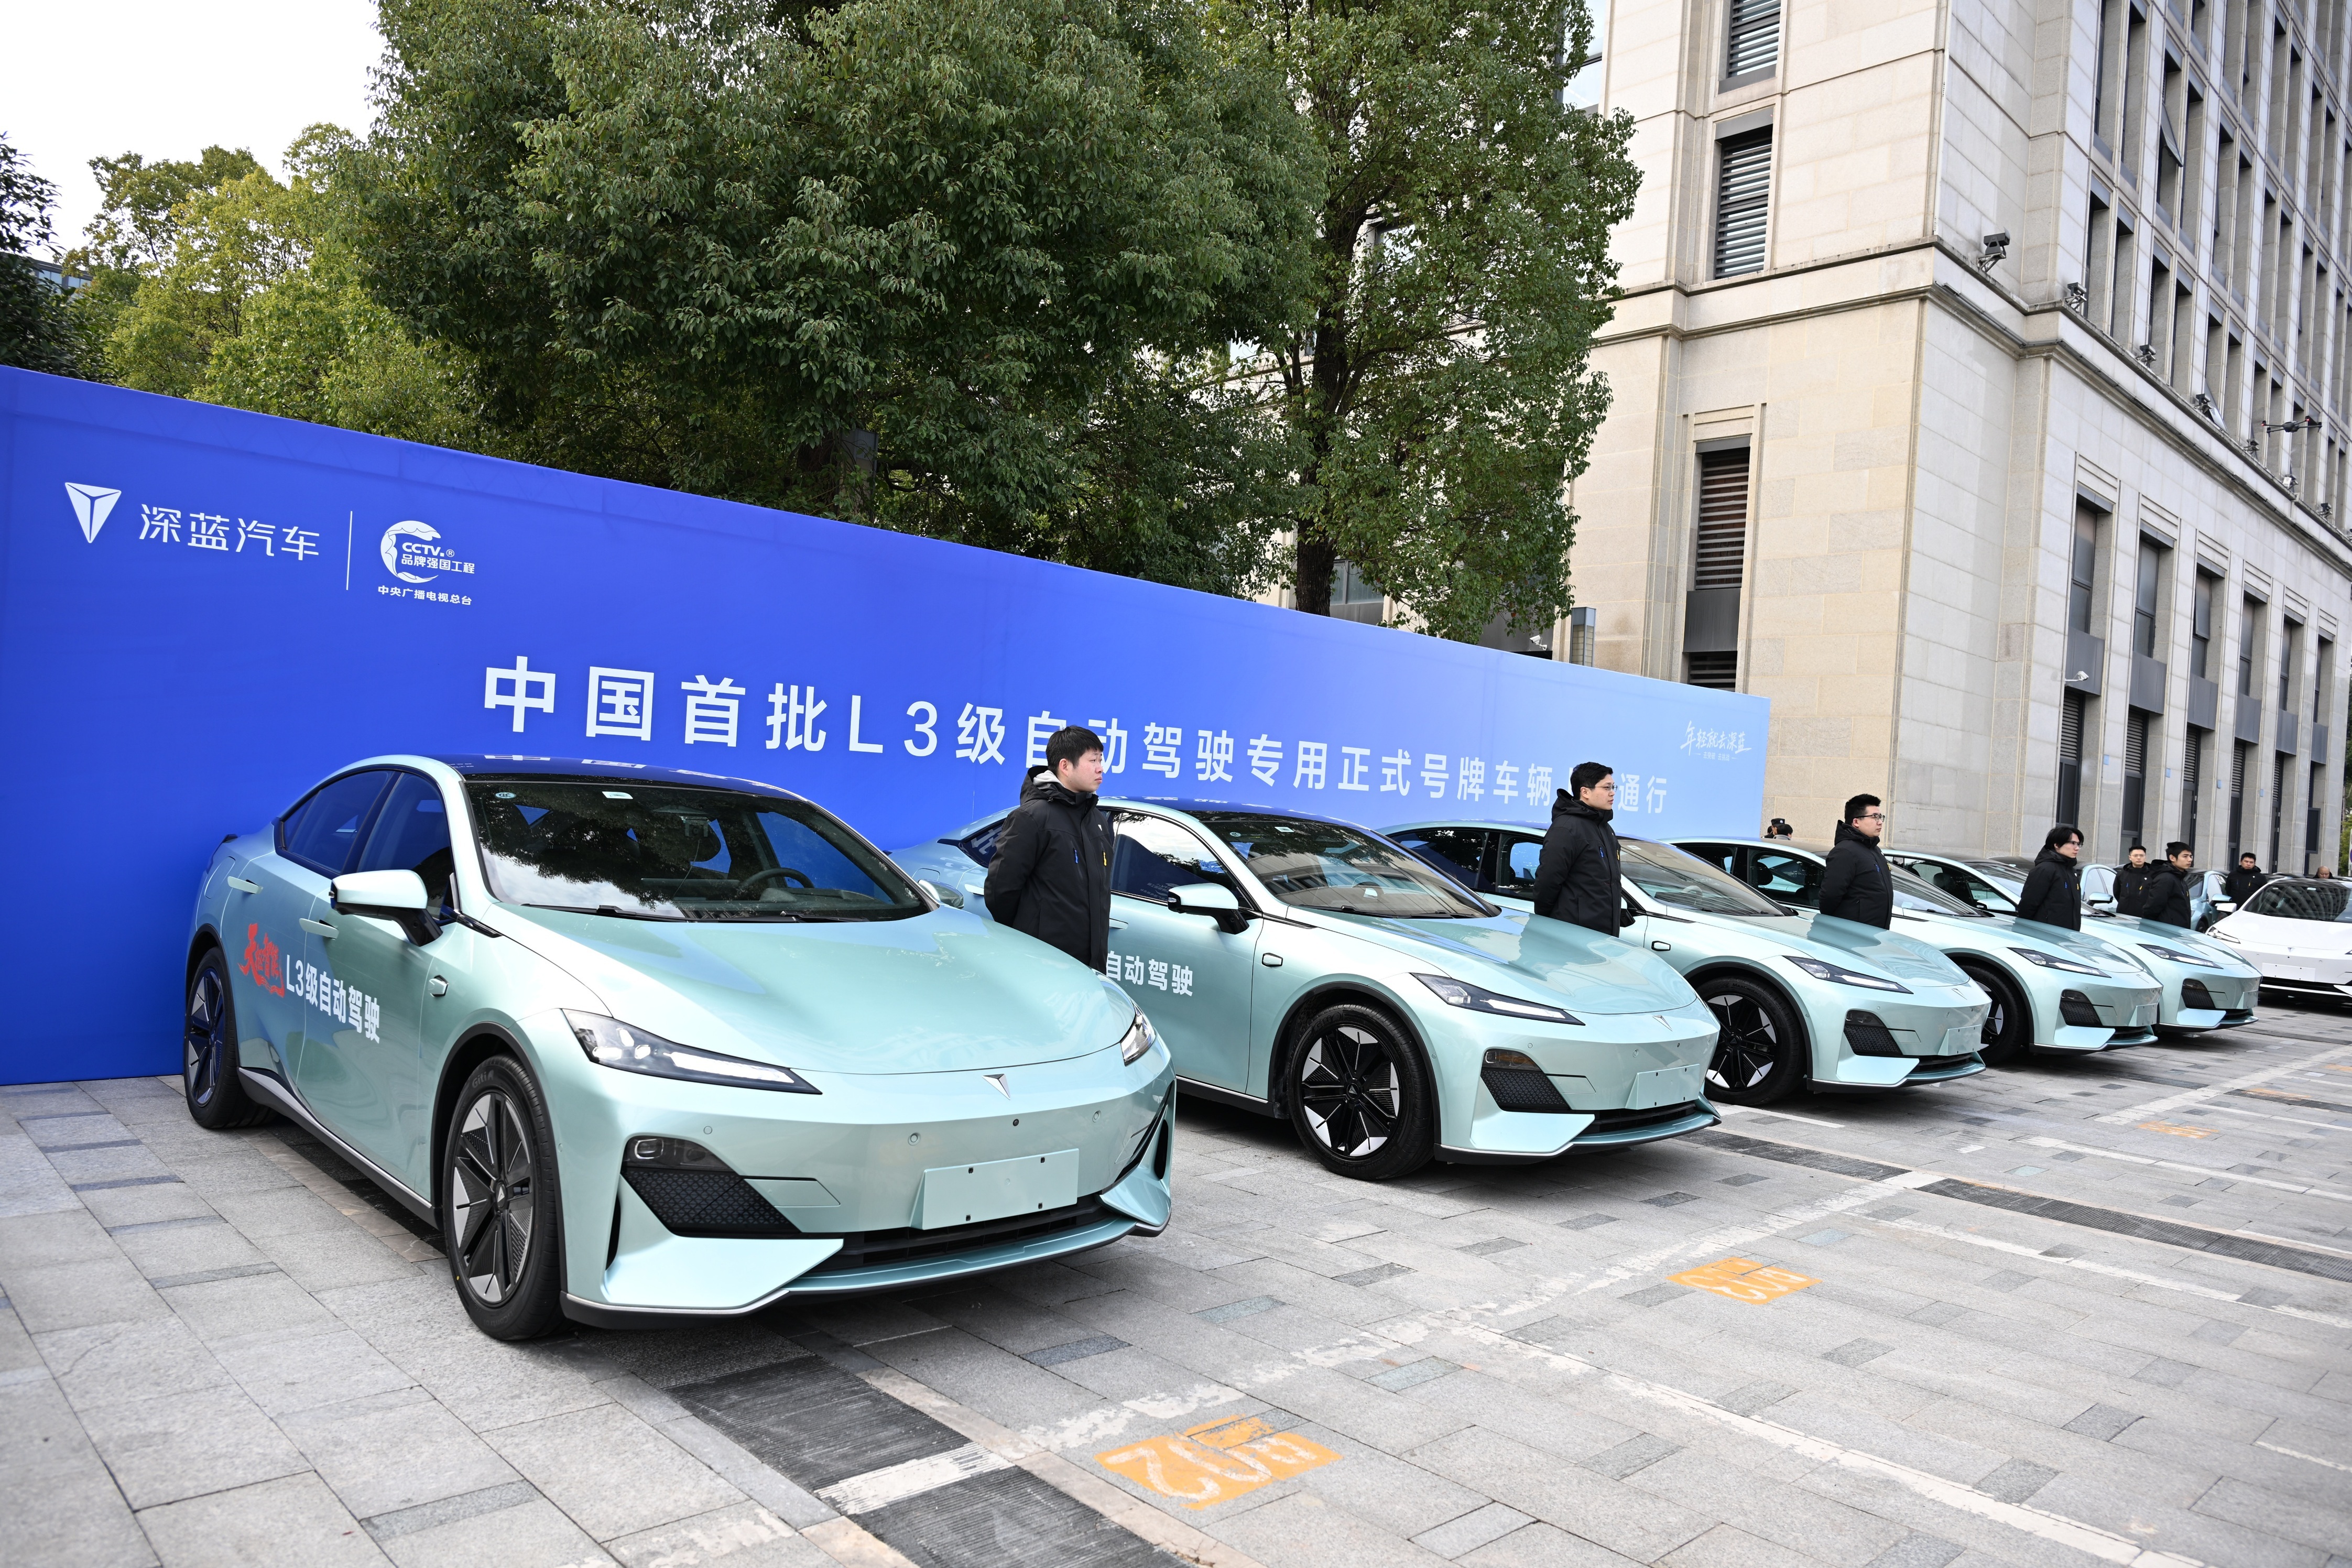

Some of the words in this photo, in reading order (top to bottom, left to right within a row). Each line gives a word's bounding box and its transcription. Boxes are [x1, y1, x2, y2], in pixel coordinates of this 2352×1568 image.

[138, 504, 320, 561] 深蓝汽车
[401, 553, 475, 574] 品牌强国工程
[378, 585, 472, 605] 中央广播电视总台
[1106, 950, 1193, 997] 自动驾驶
[286, 954, 380, 1044] L3级自动驾驶
